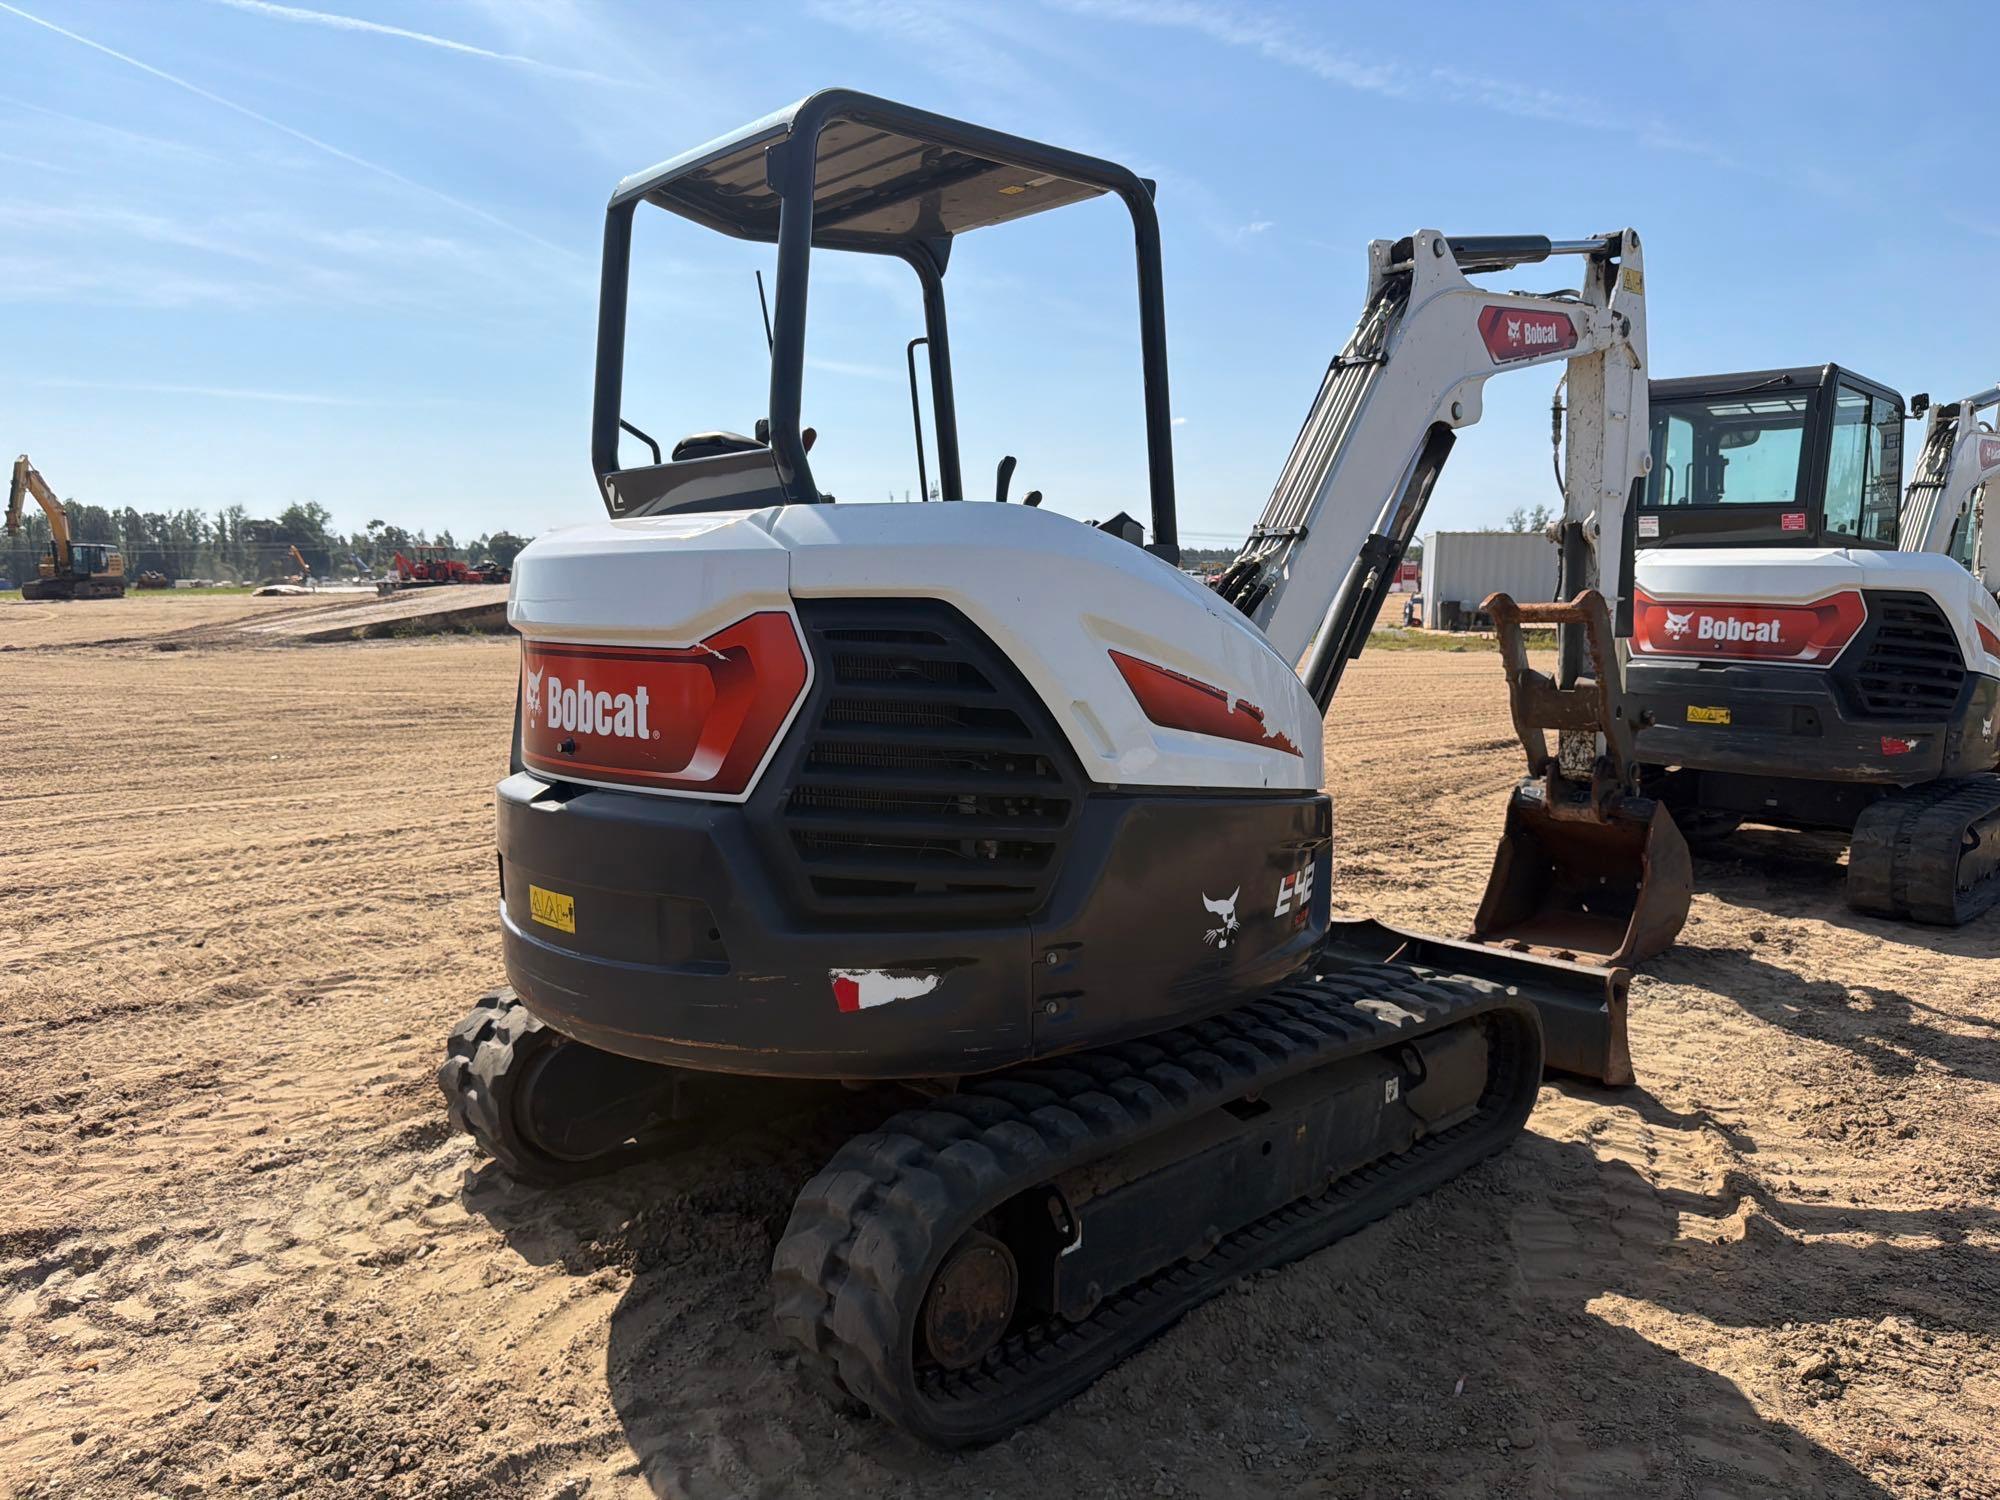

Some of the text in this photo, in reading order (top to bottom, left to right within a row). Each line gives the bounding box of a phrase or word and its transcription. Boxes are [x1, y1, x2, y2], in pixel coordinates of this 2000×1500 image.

[1524, 322, 1557, 345] Bobcat
[1698, 616, 1781, 643] Bobcat
[547, 676, 650, 740] Bobcat
[1274, 862, 1316, 918] E42
